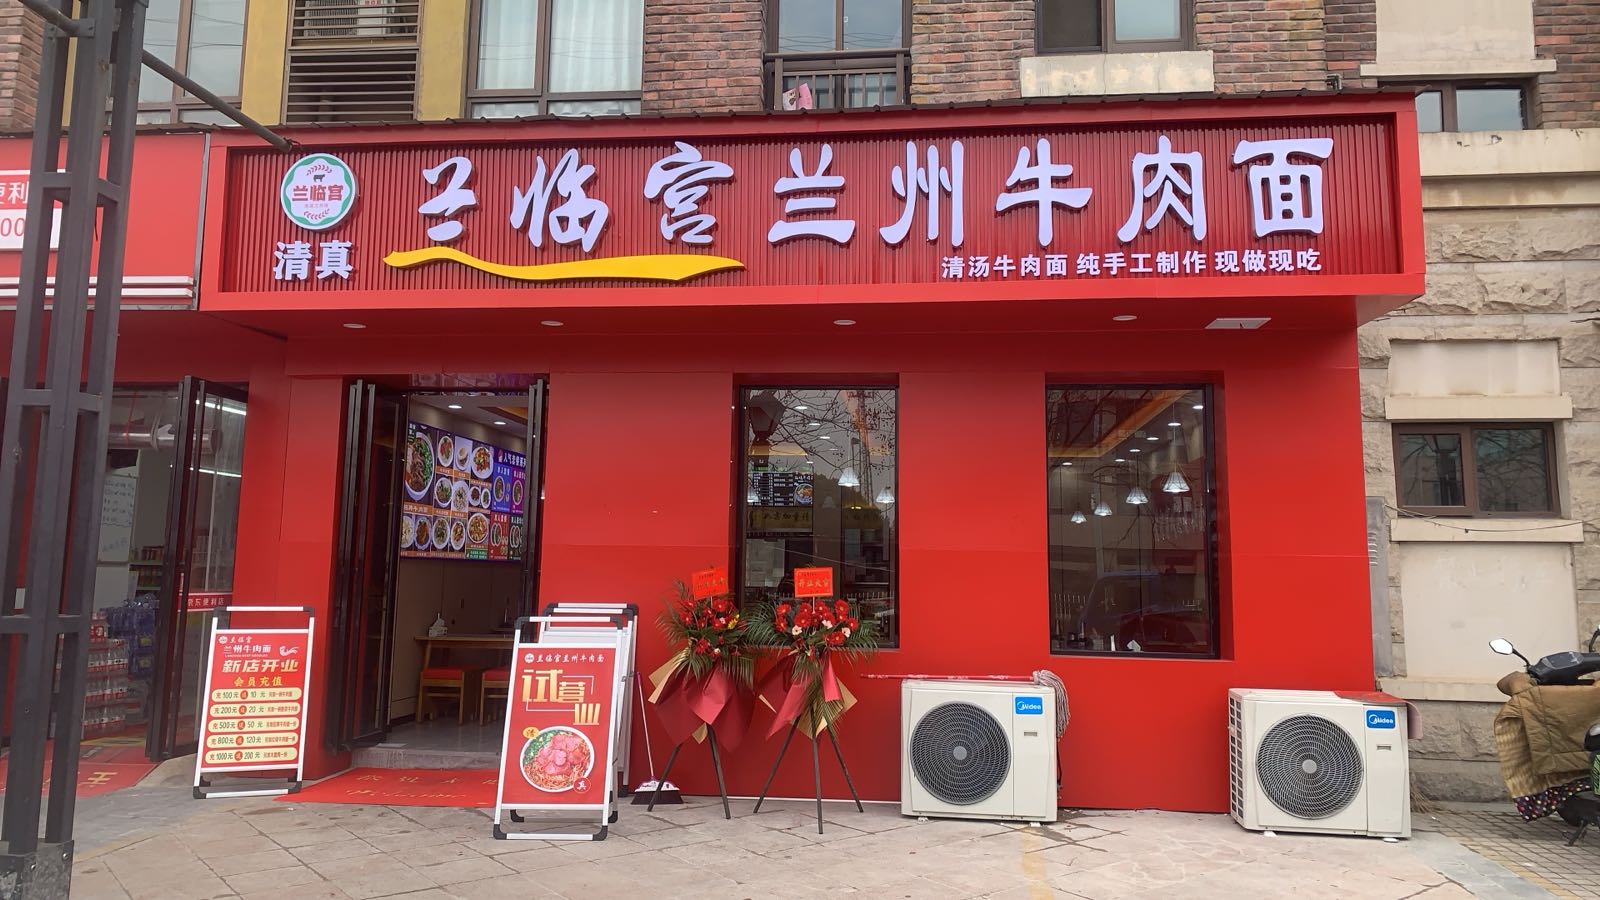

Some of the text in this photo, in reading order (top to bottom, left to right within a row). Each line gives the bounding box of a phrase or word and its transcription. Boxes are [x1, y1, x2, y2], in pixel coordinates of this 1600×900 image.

[292, 184, 344, 202] 兰临宫
[273, 239, 353, 280] 清真
[941, 248, 1322, 280] 清汤牛肉面 纯手工制作 现做现吃
[223, 644, 272, 654] 兰州牛肉面
[222, 659, 299, 673] 新店开业
[234, 676, 283, 687] 会员充值
[1016, 700, 1042, 711] Midea
[1368, 713, 1394, 725] Midea
